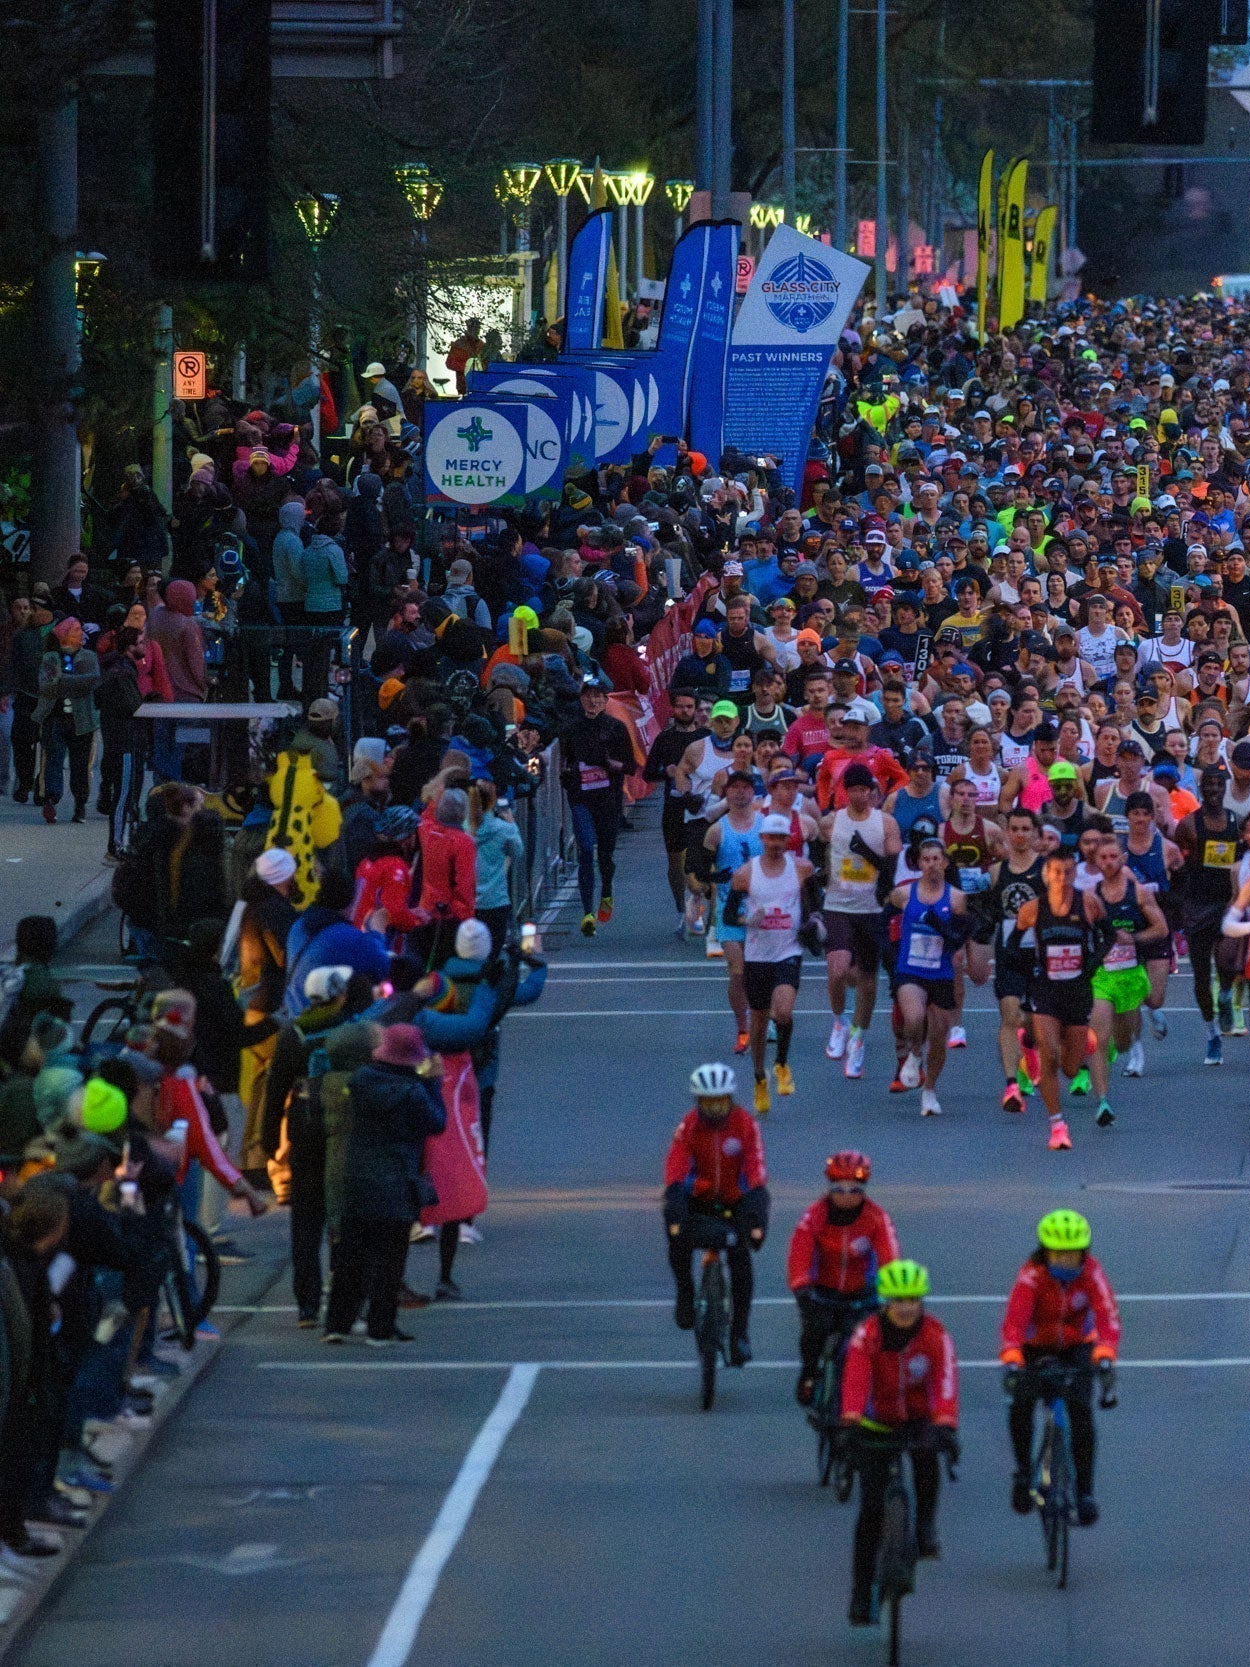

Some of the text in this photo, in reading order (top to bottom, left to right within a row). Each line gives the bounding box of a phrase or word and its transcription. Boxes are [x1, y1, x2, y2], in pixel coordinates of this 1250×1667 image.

[761, 282, 806, 293] GLASS
[810, 282, 841, 293] CITY
[773, 293, 830, 301] MARATHON
[732, 352, 823, 362] PAST WINNERS
[445, 459, 502, 472] MERCY
[441, 474, 506, 487] HEALTH
